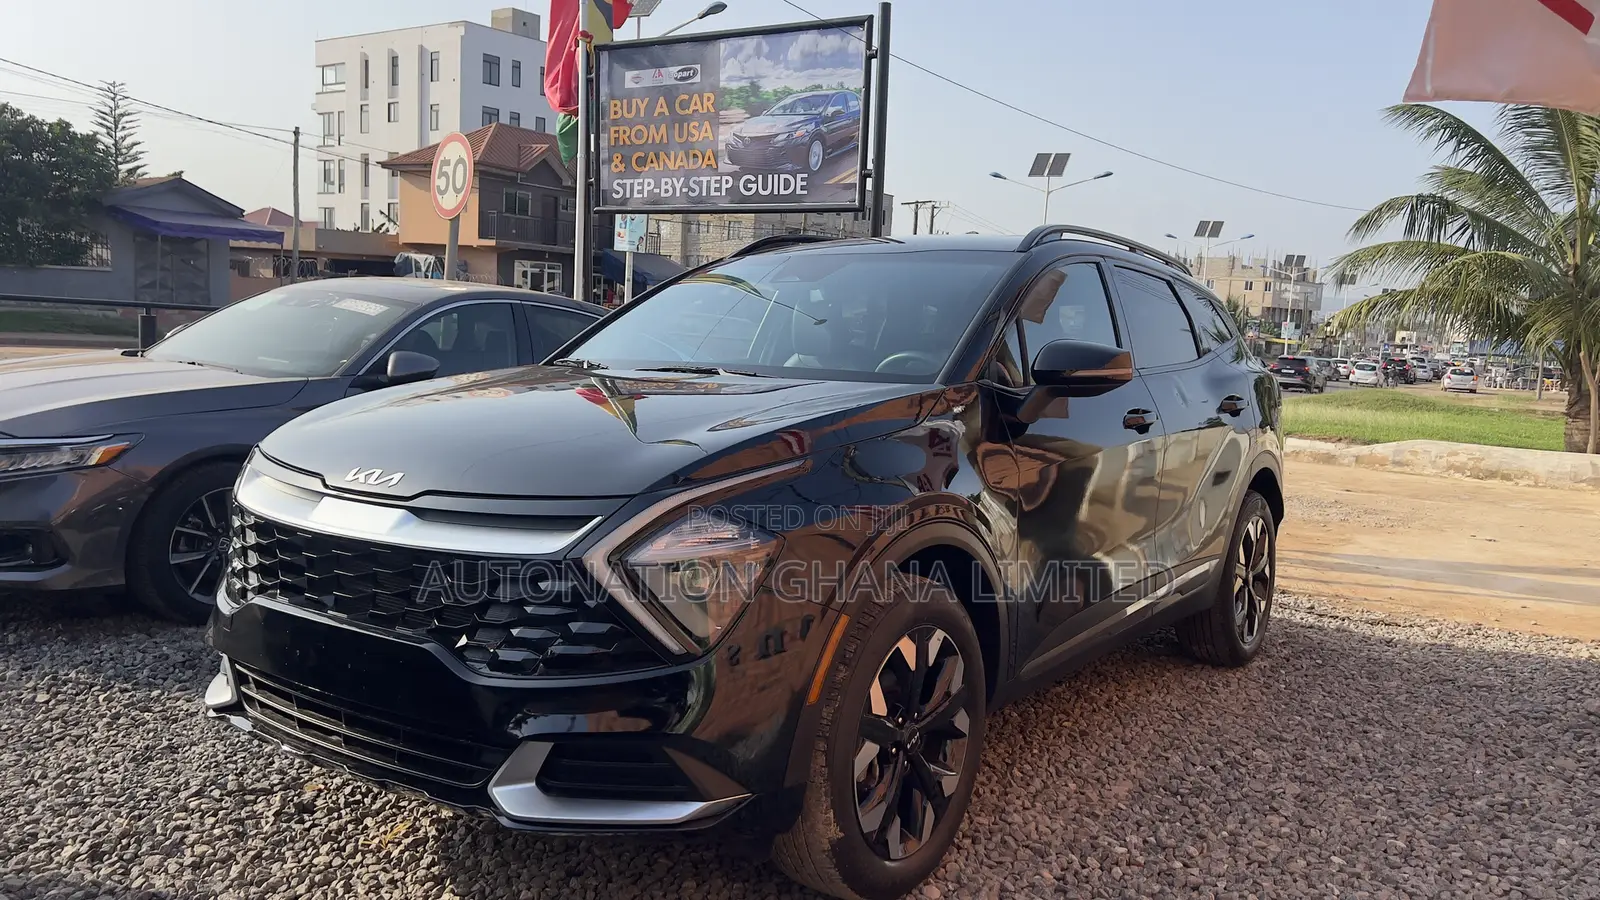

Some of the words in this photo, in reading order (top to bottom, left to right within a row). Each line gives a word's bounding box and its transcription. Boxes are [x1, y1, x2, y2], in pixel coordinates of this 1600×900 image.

[610, 97, 649, 120] BUY
[653, 96, 670, 117] A
[675, 92, 715, 115] CAR
[610, 123, 668, 146] FROM
[674, 120, 714, 143] USA
[610, 152, 626, 173] &
[631, 148, 718, 172] CANADA
[436, 157, 468, 196] 50
[612, 175, 733, 199] STEP-BY-STEP
[739, 173, 809, 196] GUIDE
[344, 466, 406, 489] KIA
